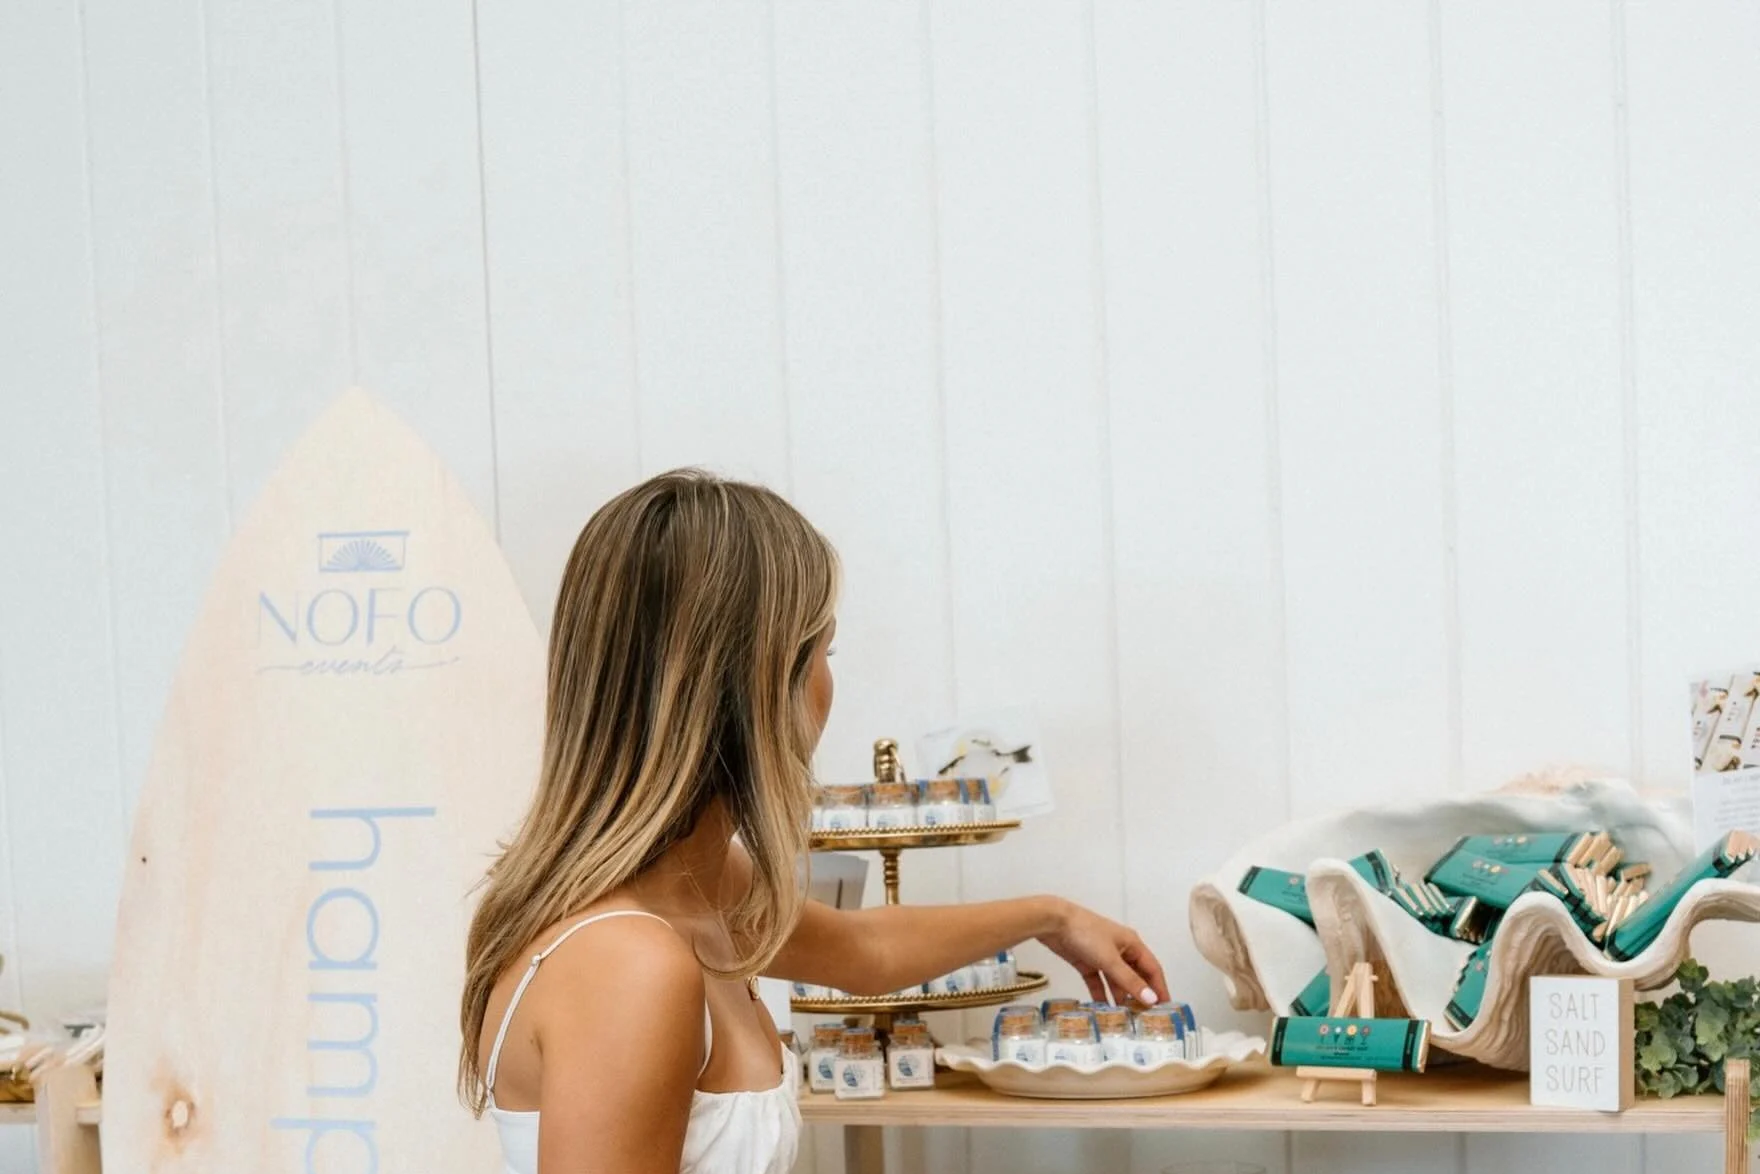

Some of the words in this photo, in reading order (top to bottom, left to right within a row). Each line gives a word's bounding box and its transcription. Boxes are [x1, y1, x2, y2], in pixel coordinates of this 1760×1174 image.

[257, 586, 462, 647] NOFO
[1546, 993, 1600, 1021] SALT
[1545, 1028, 1606, 1058] SAND
[1546, 1065, 1605, 1095] SURF
